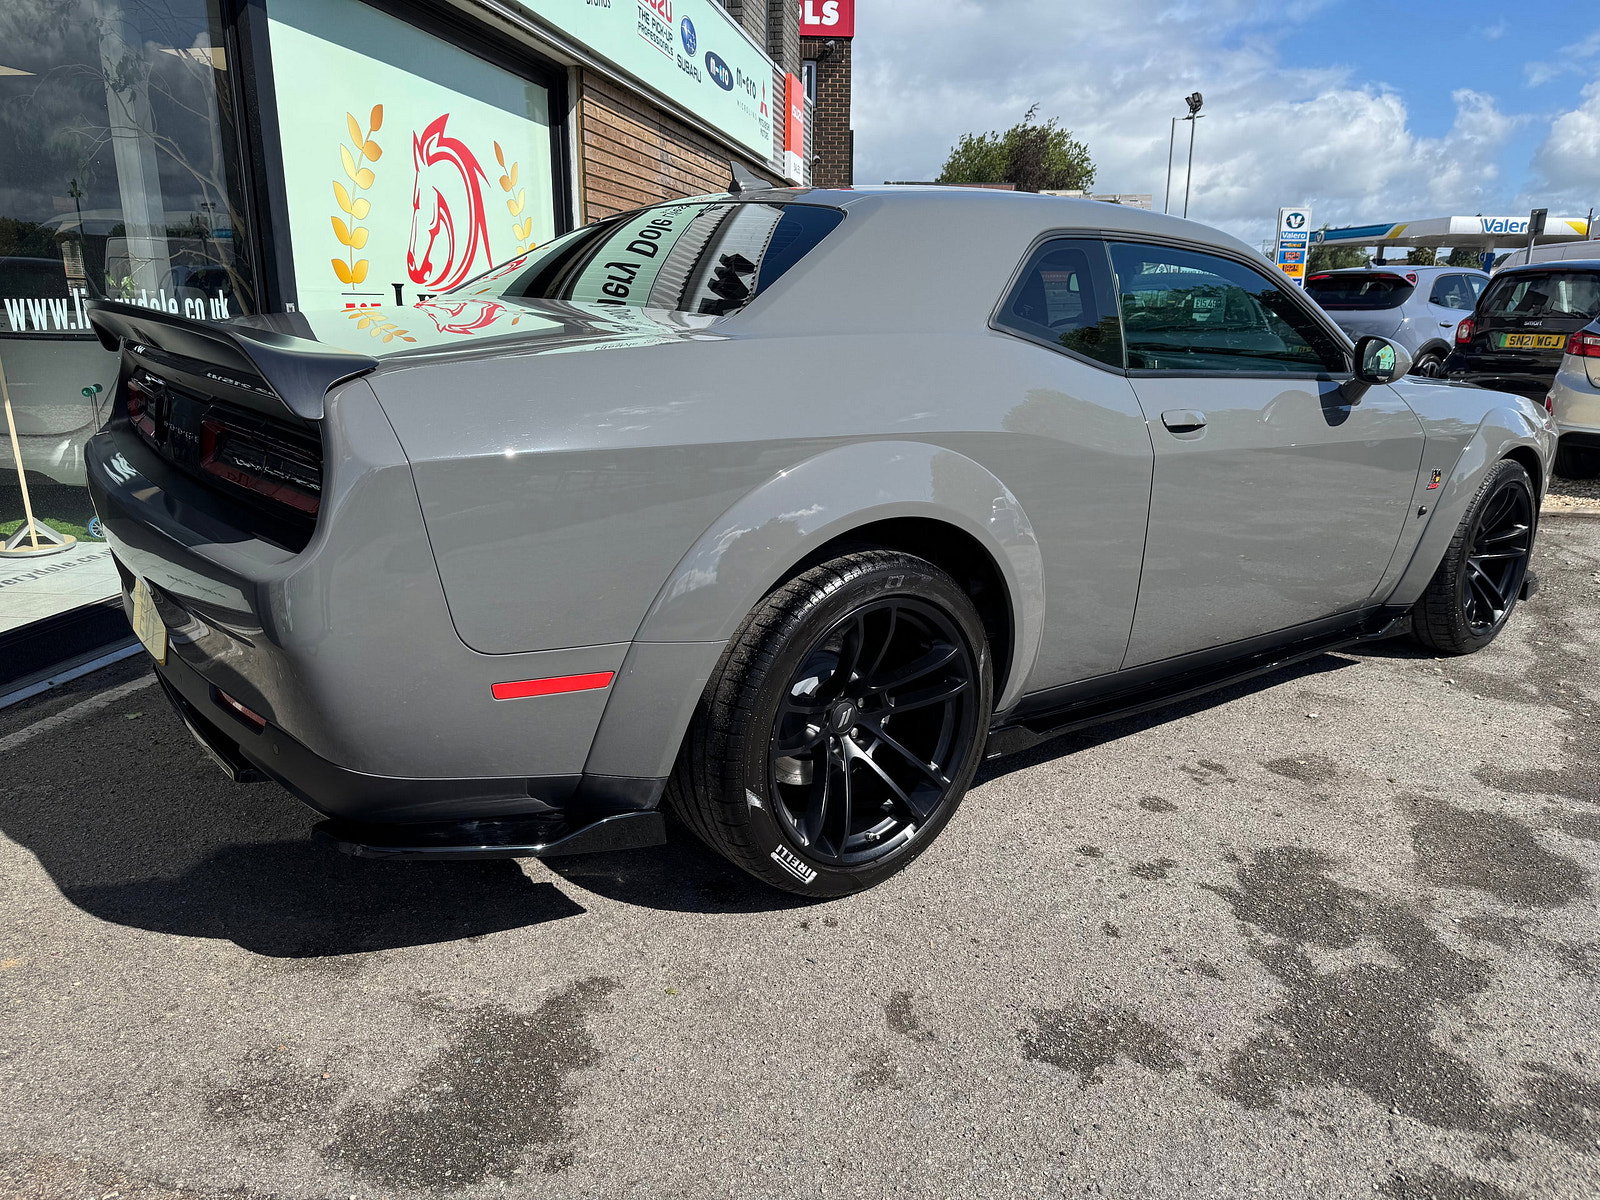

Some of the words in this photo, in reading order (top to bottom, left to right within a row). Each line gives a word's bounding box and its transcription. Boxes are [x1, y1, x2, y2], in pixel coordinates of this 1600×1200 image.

[637, 5, 650, 26] THE
[799, 0, 839, 26] LS
[676, 53, 702, 84] SUBARU
[1282, 231, 1306, 239] Valero
[1483, 218, 1528, 233] Valer
[1509, 335, 1534, 346] SN21
[1535, 335, 1560, 347] WGJ
[770, 843, 818, 884] PIRELLI
